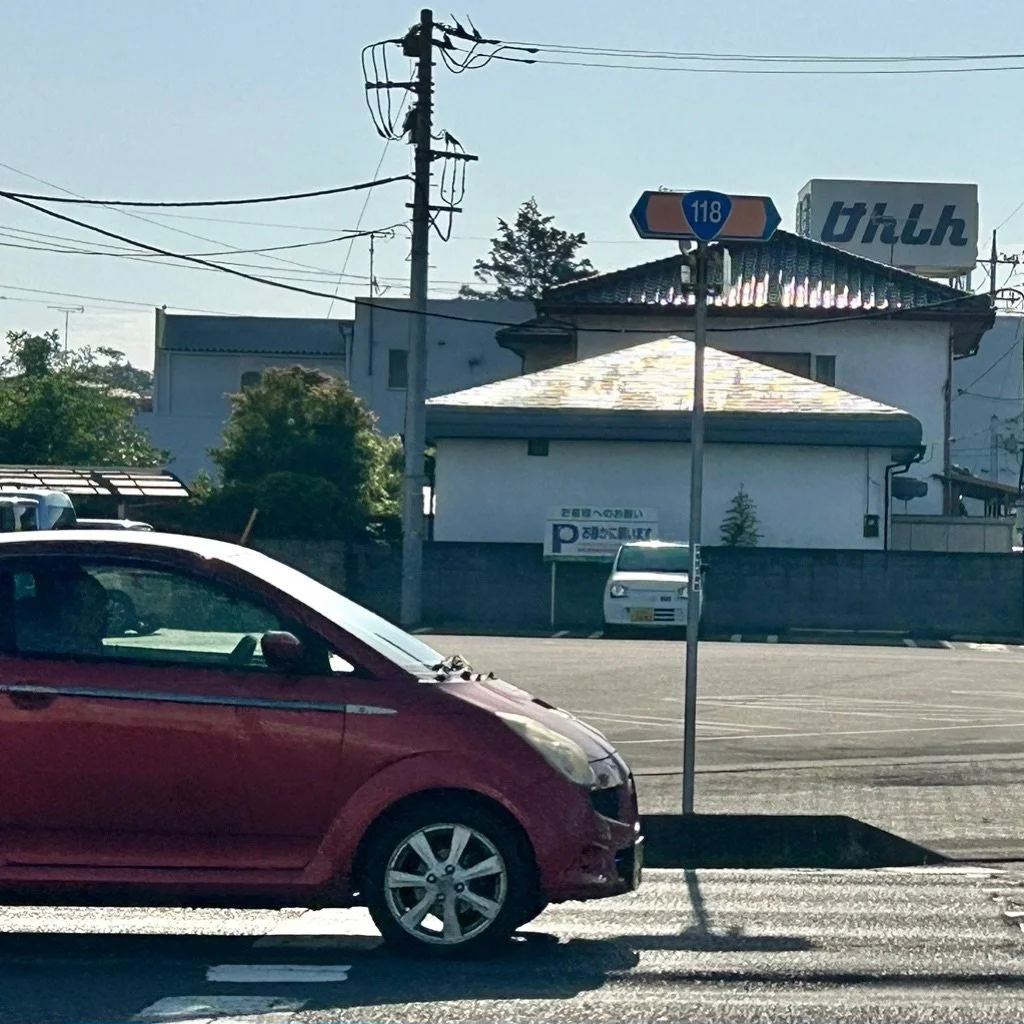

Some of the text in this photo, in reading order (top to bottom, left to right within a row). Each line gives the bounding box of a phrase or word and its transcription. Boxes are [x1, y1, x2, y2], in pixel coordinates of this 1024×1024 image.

[691, 200, 721, 223] 118
[821, 201, 968, 246] けんしん
[552, 523, 579, 553] P
